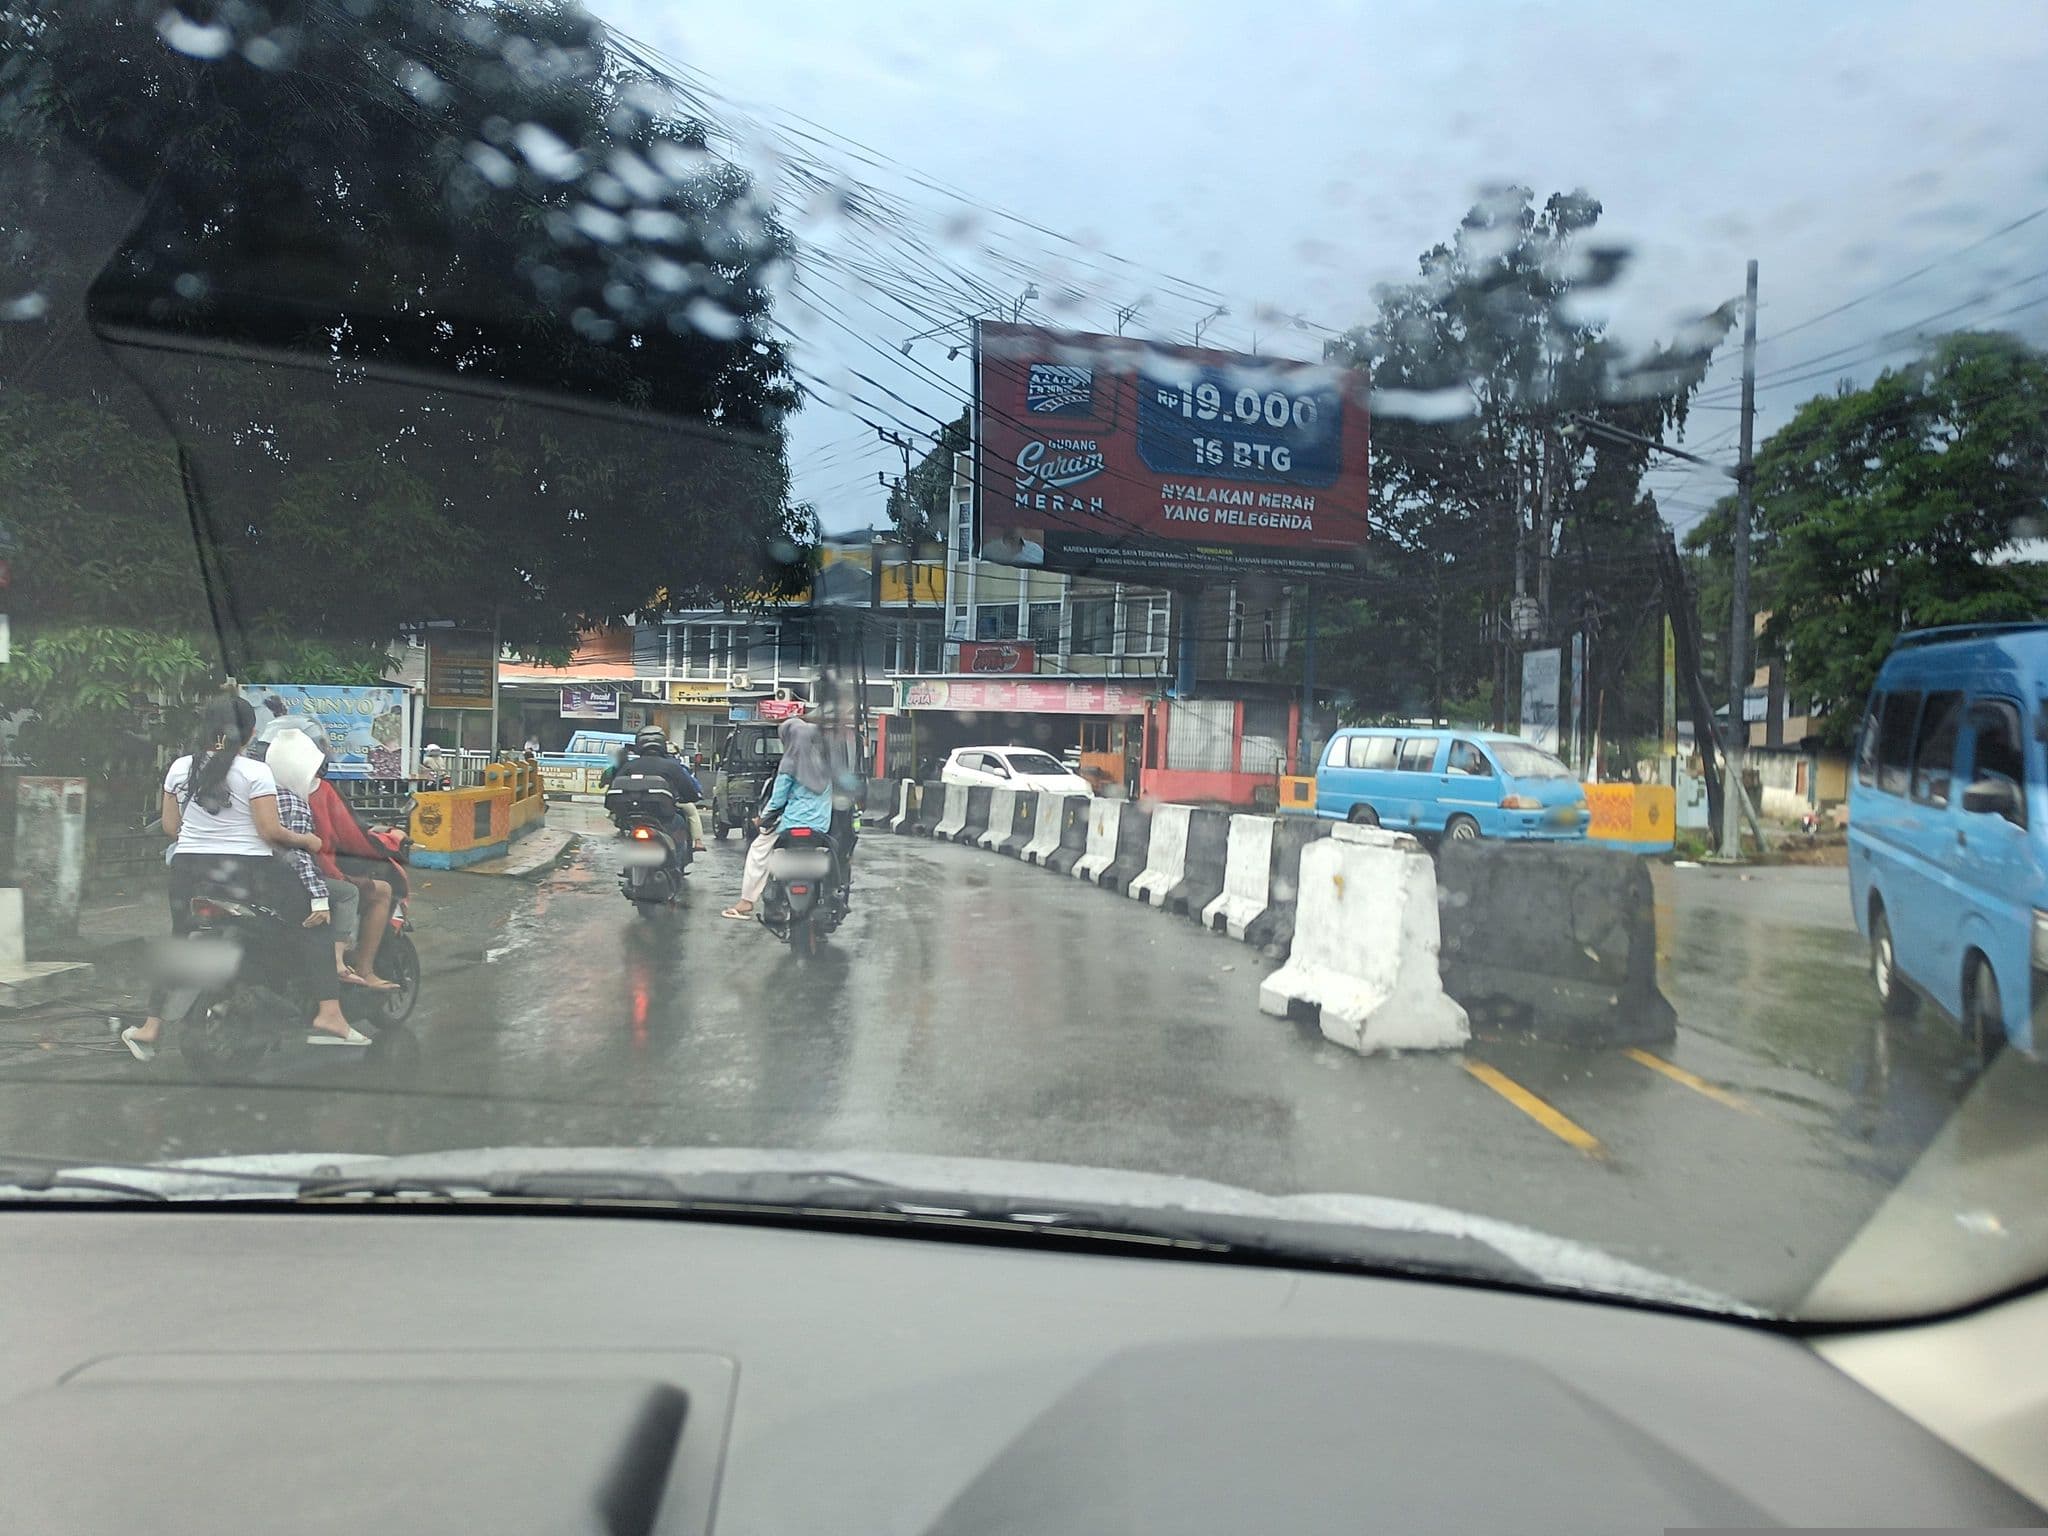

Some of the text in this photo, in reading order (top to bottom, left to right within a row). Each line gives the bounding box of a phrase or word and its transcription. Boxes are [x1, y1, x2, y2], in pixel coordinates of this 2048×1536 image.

[1048, 439, 1097, 451] GUDANG
[1233, 441, 1291, 472] BTG
[1016, 441, 1105, 489] Garam
[1015, 493, 1103, 513] MERAH
[1161, 483, 1315, 511] NYALAKAN MERAH
[1163, 504, 1313, 531] YANG MELEGENDA
[303, 697, 373, 715] SINYO
